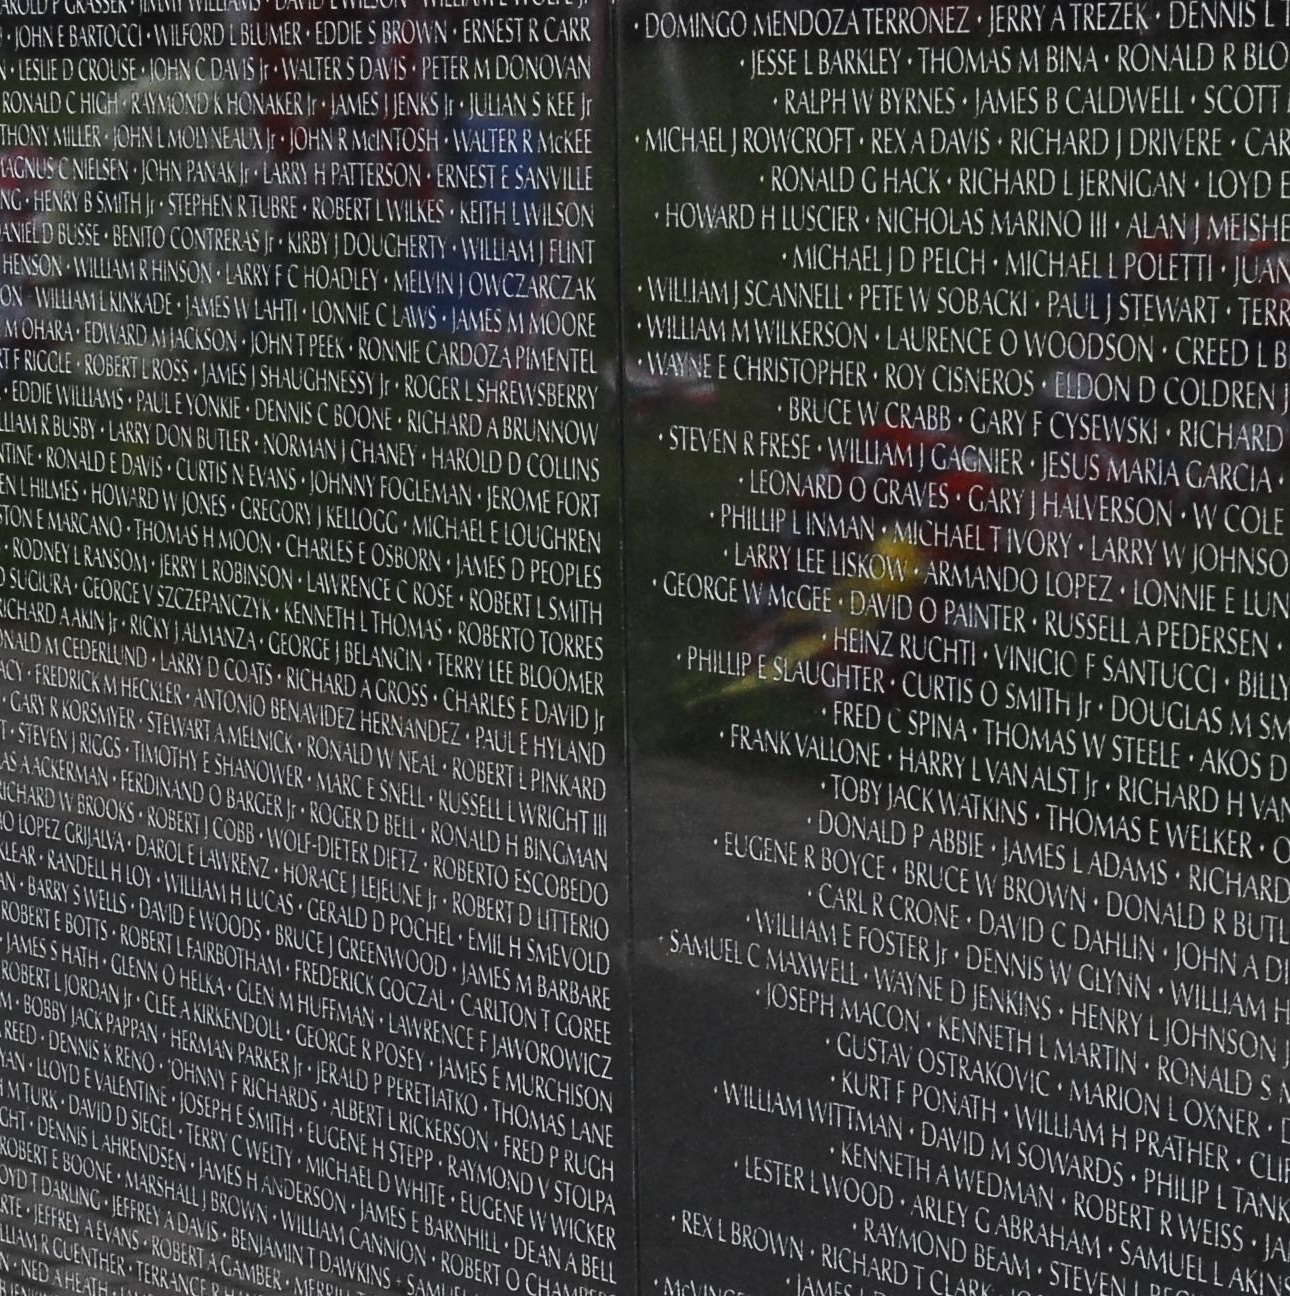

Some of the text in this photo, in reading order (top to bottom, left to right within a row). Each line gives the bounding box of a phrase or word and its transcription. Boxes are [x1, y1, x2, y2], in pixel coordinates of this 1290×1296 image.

[464, 17, 591, 43] ERNEST R CARR
[423, 55, 590, 80] PETER M DONOVAN
[646, 126, 854, 157] MICHAEL J ROWCROFT
[772, 165, 940, 194] RONALD G HACK
[666, 203, 859, 232] HOWARD H LUSCIER
[434, 855, 608, 906] ROBERTO ESCOBEDO
[469, 928, 609, 975] EMIL H SMEVOLD
[724, 1081, 1123, 1187] WILLIAM WITTMAN DAVID M SOWARDS
[683, 1210, 803, 1261] REX L BROWN
